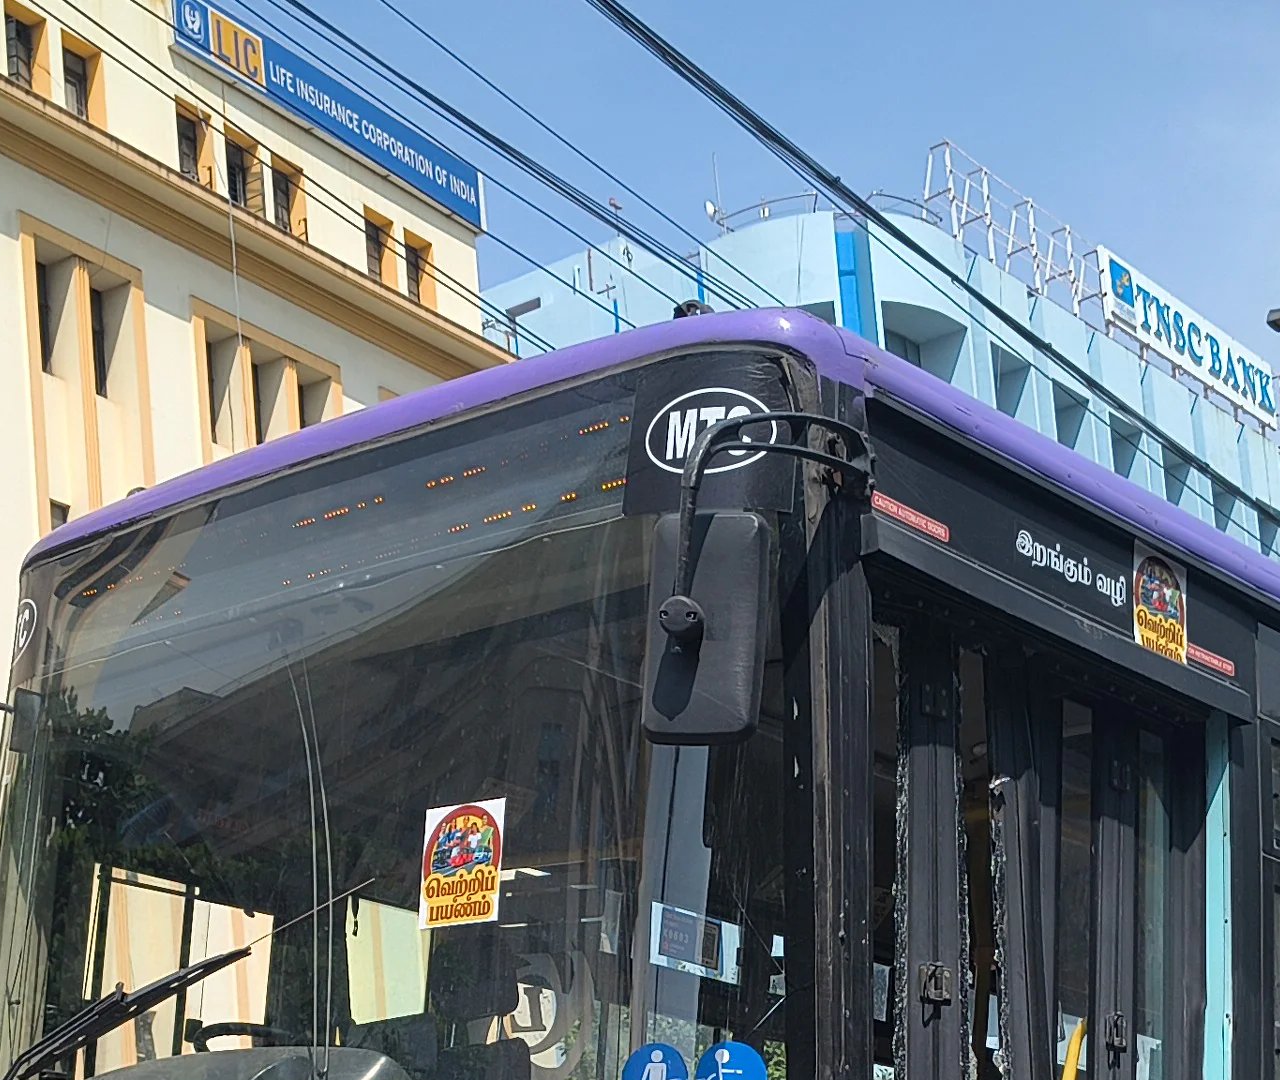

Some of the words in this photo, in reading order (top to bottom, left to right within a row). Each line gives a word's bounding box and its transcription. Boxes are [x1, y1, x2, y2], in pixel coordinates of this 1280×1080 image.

[216, 19, 259, 82] LIC
[270, 61, 294, 93] LIFE
[296, 77, 361, 134] INSURANCE
[361, 119, 434, 180] CORPORATION
[435, 164, 448, 187] OF
[449, 174, 478, 207] INDIA
[1135, 284, 1204, 367] TNSC
[1205, 332, 1276, 418] BANK
[1015, 529, 1093, 586] இறங்கும்
[1096, 571, 1128, 607] வழி
[1136, 608, 1184, 648] வெற்றிப்
[425, 869, 496, 903] வெற்றிப்
[429, 894, 491, 921] பயணம்
